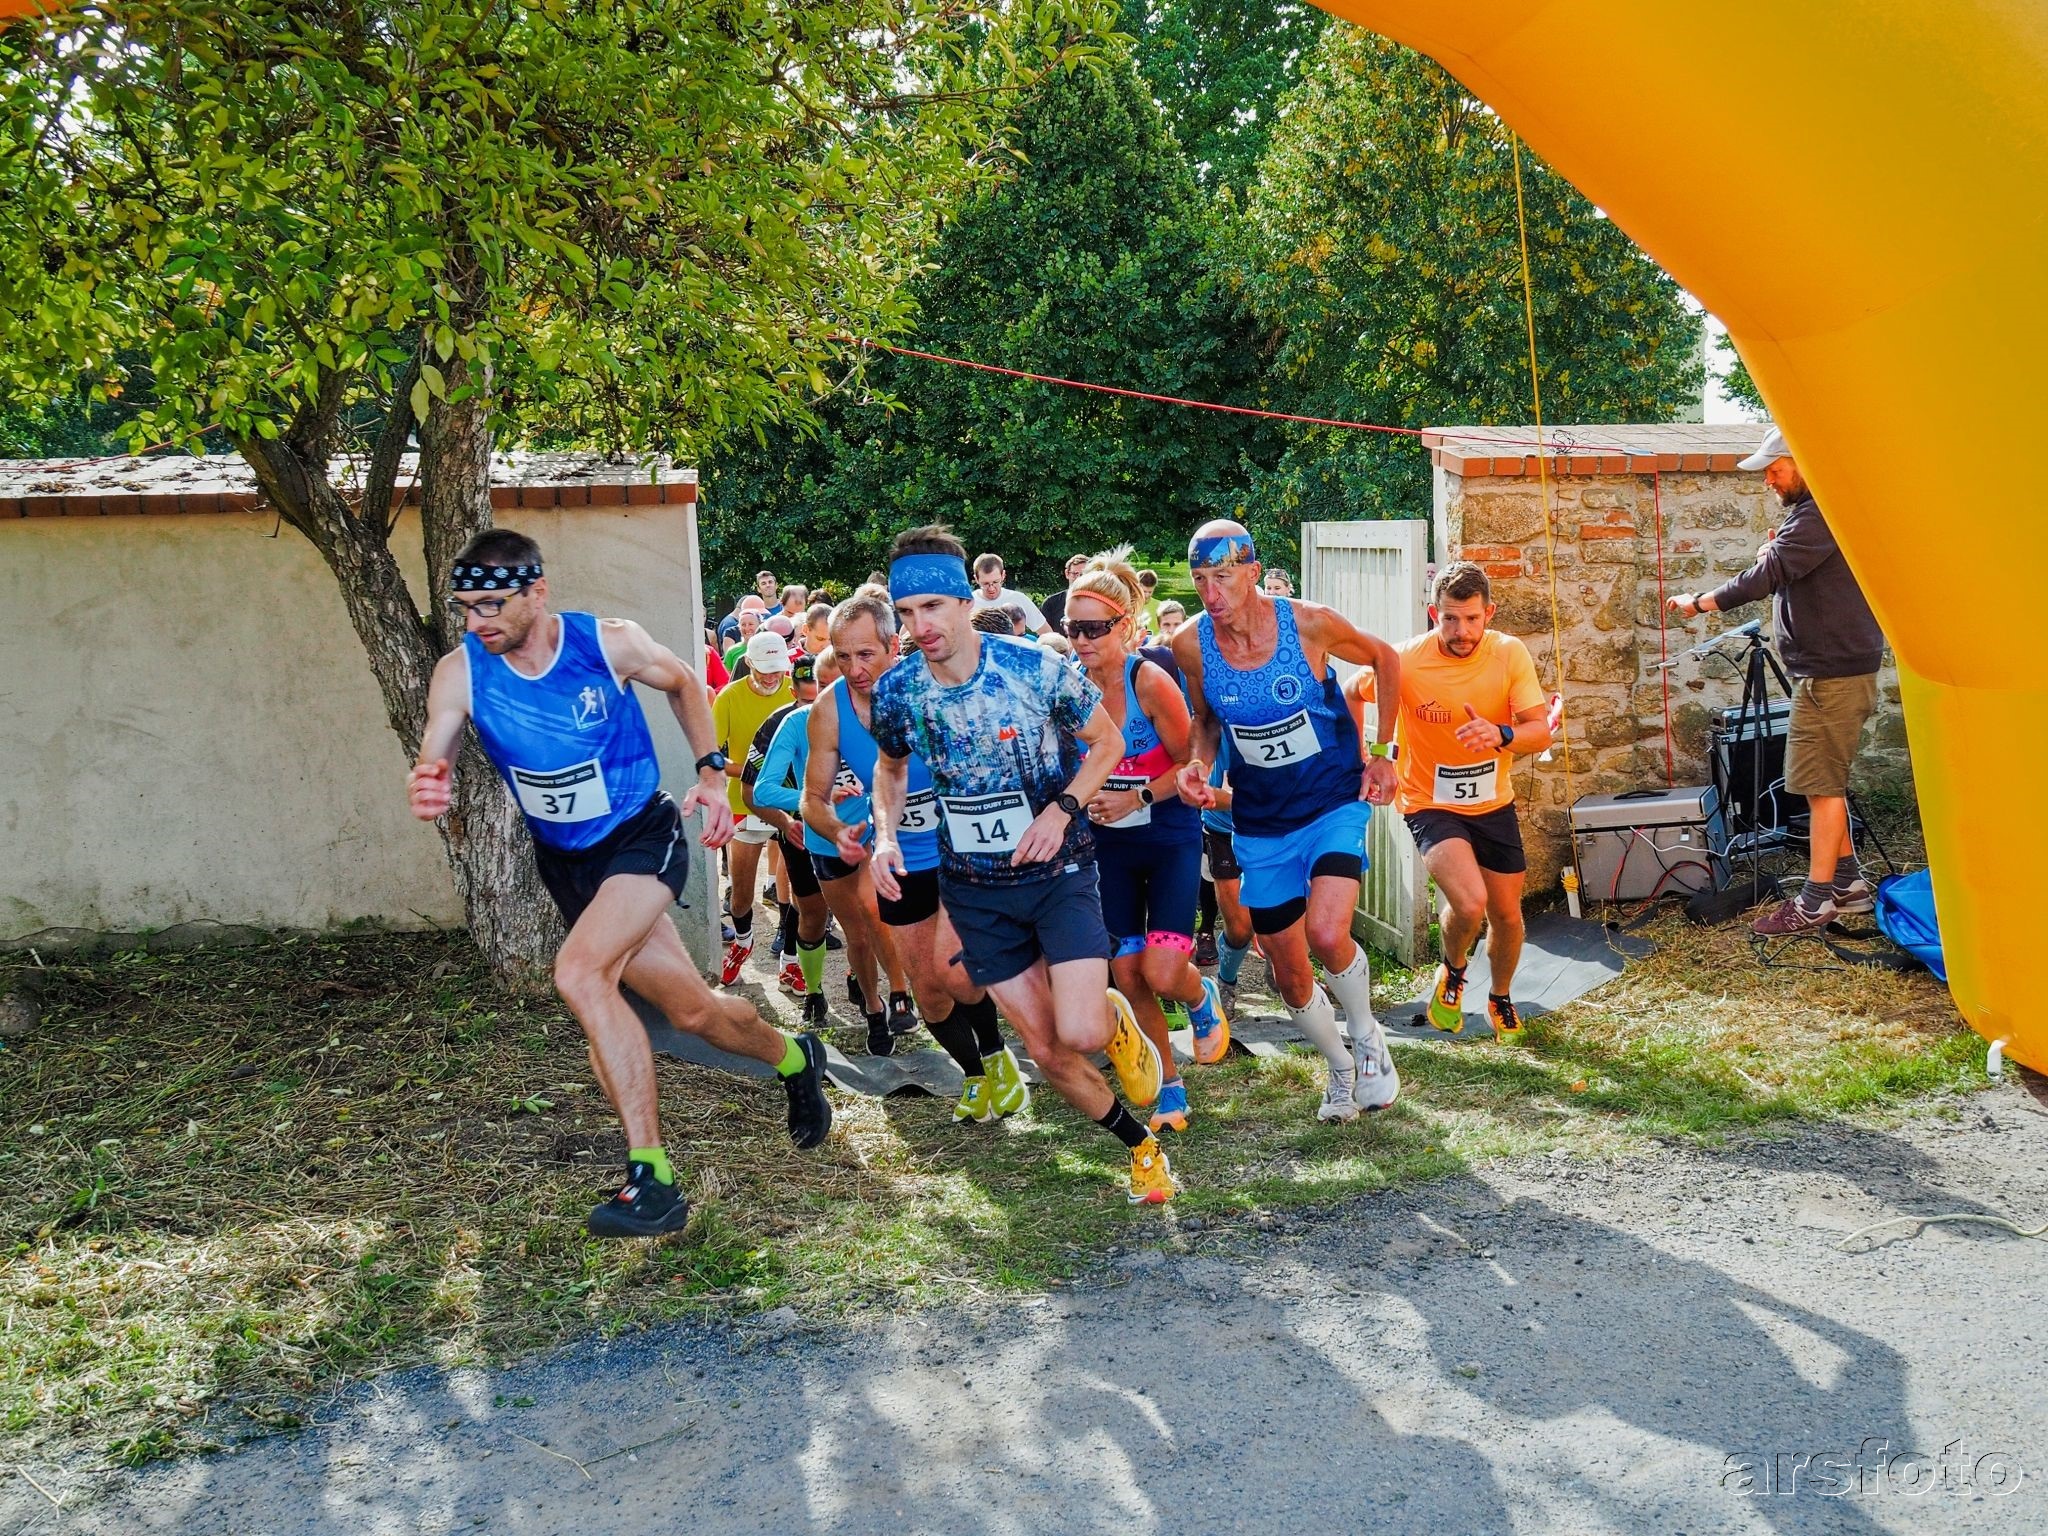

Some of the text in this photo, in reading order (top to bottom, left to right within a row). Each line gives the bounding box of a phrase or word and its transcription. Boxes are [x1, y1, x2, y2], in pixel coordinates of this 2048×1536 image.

[1220, 694, 1239, 703] lawi
[1271, 726, 1289, 735] DUBY
[1260, 740, 1296, 762] 21
[1454, 781, 1480, 799] 51
[541, 792, 577, 815] 37
[982, 800, 1002, 811] DUBY
[971, 818, 1010, 844] 14
